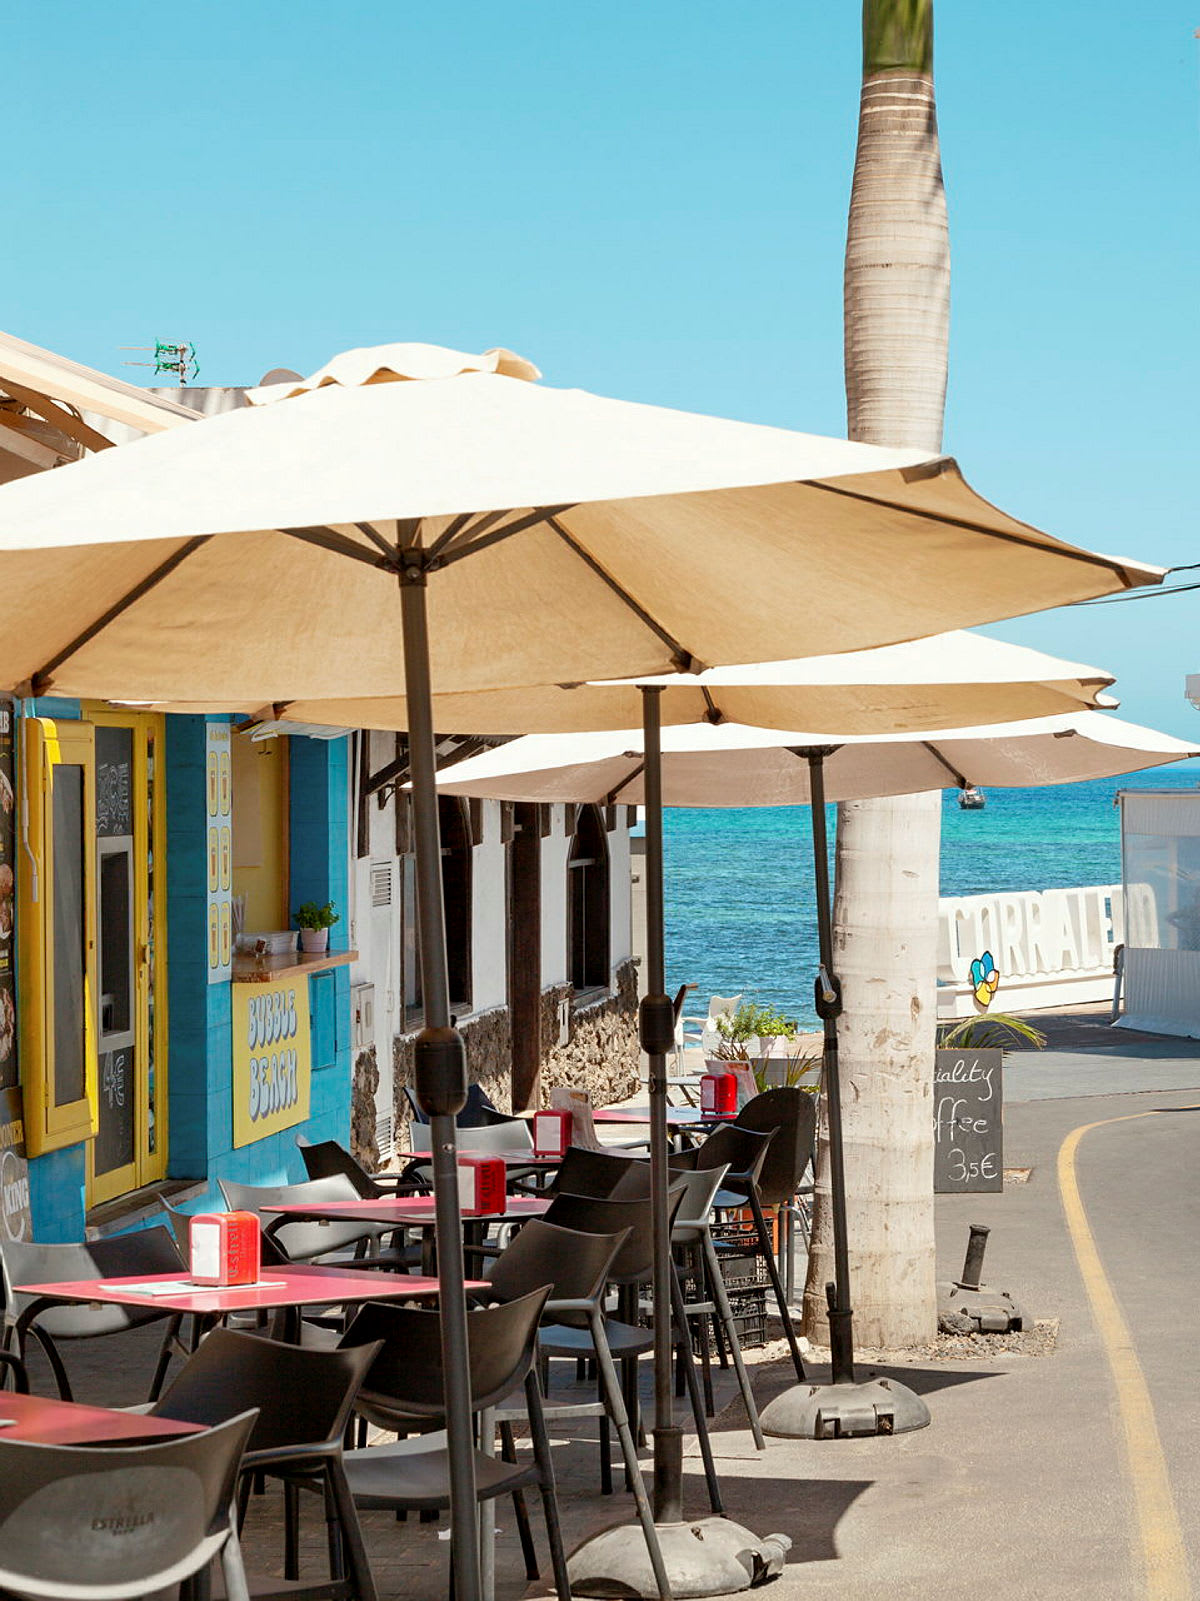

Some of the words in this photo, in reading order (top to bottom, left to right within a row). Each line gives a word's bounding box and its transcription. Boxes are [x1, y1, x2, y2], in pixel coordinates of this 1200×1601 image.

[248, 989, 298, 1051] BUBBLE
[249, 1048, 298, 1123] BEACH
[933, 1059, 994, 1102] iality
[947, 1148, 998, 1183] 3,5€
